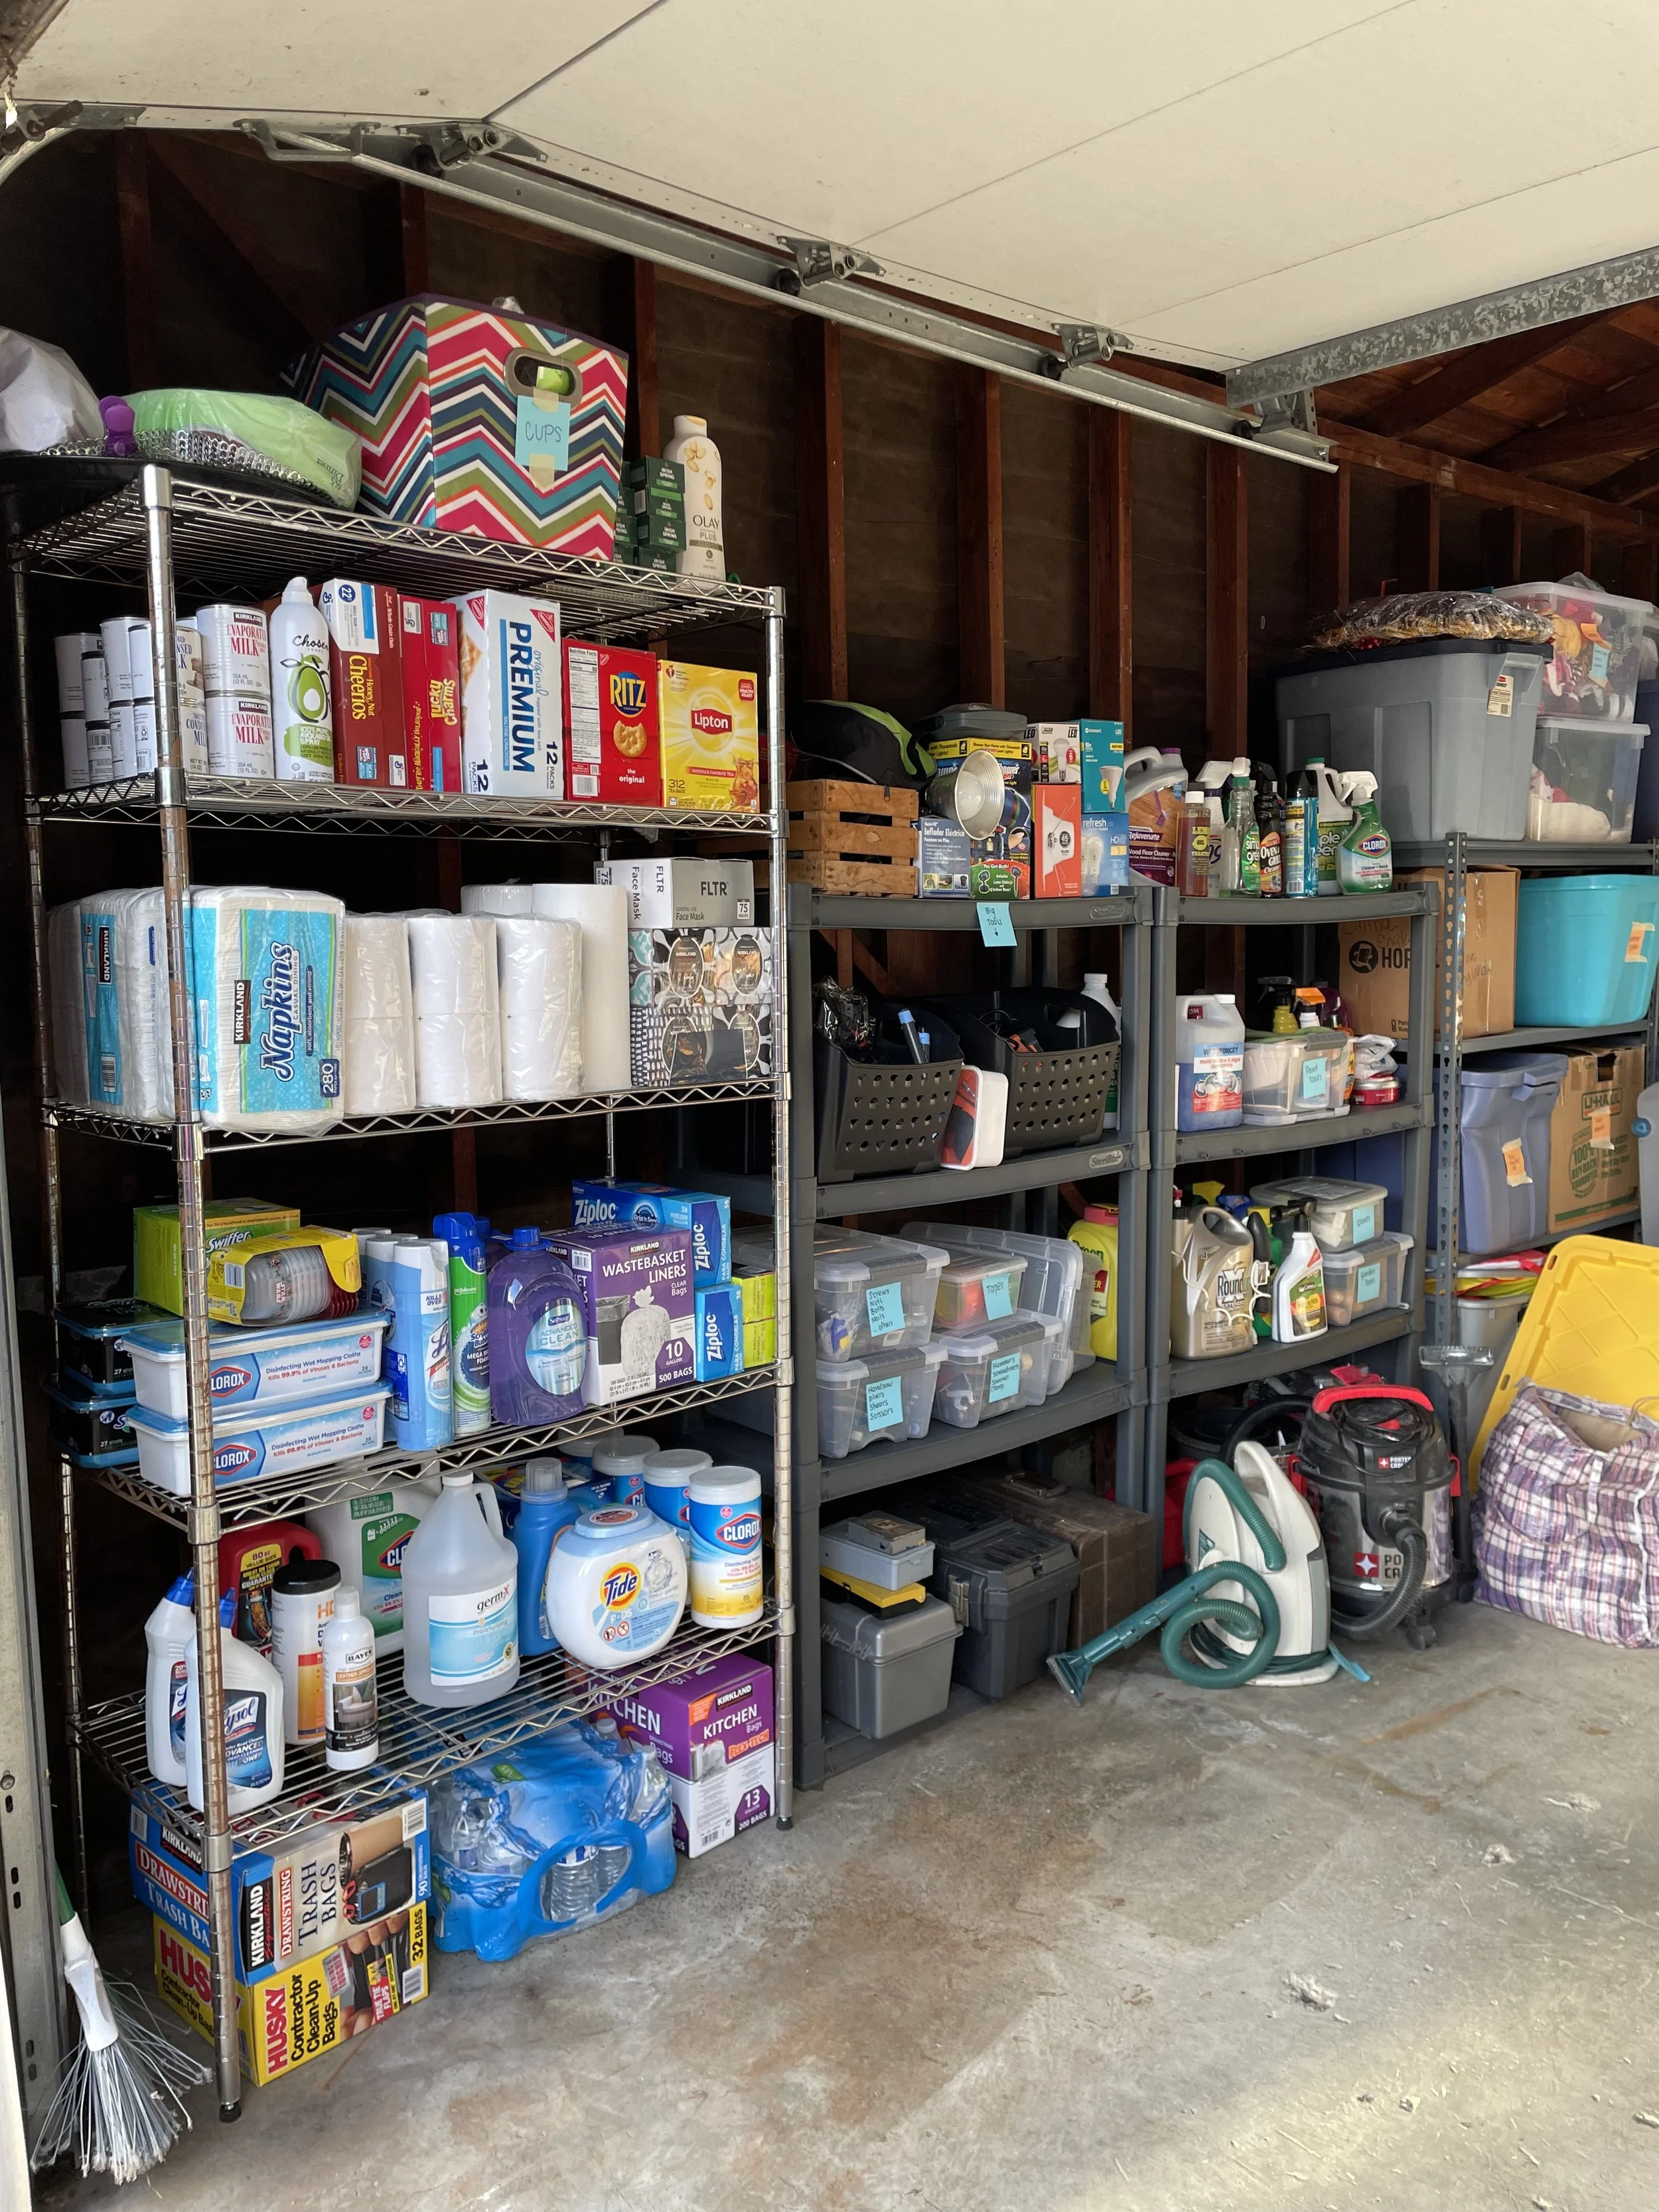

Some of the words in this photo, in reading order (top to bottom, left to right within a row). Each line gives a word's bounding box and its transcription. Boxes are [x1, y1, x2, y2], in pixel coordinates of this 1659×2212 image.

[525, 421, 562, 443] CUPS
[693, 514, 720, 530] OLAY
[235, 612, 263, 623] KIRKLAND
[232, 636, 259, 657] MILK
[533, 650, 549, 697] original
[349, 654, 367, 720] Cheerios
[509, 621, 535, 773] PREMIUM
[610, 674, 646, 708] RITZ
[240, 701, 268, 711] KIRKLAND
[694, 713, 729, 729] Lipton
[236, 726, 265, 745] MILK
[1024, 728, 1036, 739] LED
[1068, 727, 1078, 738] LED
[546, 741, 558, 765] 12
[476, 759, 488, 792] 12
[618, 775, 645, 784] original
[668, 779, 685, 789] 312
[924, 828, 945, 836] Inflador
[945, 828, 966, 837] Eléctrico
[1083, 817, 1107, 828] refresh
[1129, 831, 1160, 842] Rejuvenate
[1362, 840, 1388, 851] CLOROX
[701, 881, 727, 896] FLTR
[633, 893, 642, 921] Mask
[676, 912, 689, 921] Face
[690, 912, 705, 921] Mask
[739, 903, 748, 913] 75
[235, 981, 245, 1042] KIRKLAND
[261, 941, 303, 1082] Napkins
[323, 1063, 334, 1094] 280
[1090, 1153, 1122, 1167] Sterilite
[575, 1199, 616, 1226] Ziploc
[724, 1199, 729, 1209] 38
[206, 1231, 250, 1254] Swiffer
[630, 1242, 660, 1254] KIRKLAND
[693, 1222, 711, 1271] Ziploc
[602, 1249, 686, 1278] WASTEBASKET
[648, 1264, 687, 1284] LINERS
[671, 1280, 687, 1289] CLEAR
[671, 1286, 687, 1297] Bags
[736, 1290, 741, 1300] 38
[869, 1289, 890, 1300] Screws
[986, 1281, 1004, 1295] Tapes
[871, 1313, 885, 1323] Nails
[540, 1323, 577, 1337] ADVANCED
[540, 1329, 579, 1346] CLEAN
[707, 1313, 723, 1363] Ziploc
[666, 1341, 683, 1359] 10
[266, 1363, 301, 1374] Disinfecting
[317, 1355, 342, 1366] Mopping
[343, 1351, 361, 1361] Cloths
[281, 1370, 301, 1378] 99.9%
[337, 1359, 359, 1368] Bacteria
[659, 1372, 672, 1383] 500
[673, 1366, 693, 1378] BAGS
[271, 1439, 307, 1451] Disinfecting
[321, 1429, 346, 1439] Mopping
[347, 1423, 364, 1432] Cloths
[287, 1445, 307, 1454] 99.9%
[315, 1439, 334, 1448] Viruses
[341, 1431, 363, 1441] Bacteria
[723, 1522, 760, 1542] CLOROX
[604, 1572, 638, 1607] Tide
[717, 1685, 752, 1706] KIRKLAND
[703, 1704, 758, 1739] KITCHEN
[746, 1721, 762, 1733] Bags
[728, 1729, 770, 1760] FLEX-TECH
[744, 1789, 760, 1806] 13
[750, 1810, 767, 1826] BAGS
[321, 1862, 336, 1925] BAGS
[418, 1882, 428, 1896] 90
[144, 1879, 187, 1926] TRASH
[279, 1870, 293, 1955] DRAWSTRING
[299, 1860, 319, 1947] TRASH
[251, 1885, 263, 1967] KIRKLAND
[414, 1907, 423, 1938] BAGS
[412, 1938, 424, 1962] 32
[161, 1969, 200, 2009] Contractor
[381, 1985, 392, 2010] FLAPS
[291, 1974, 304, 2062] Contractor
[306, 1980, 321, 2053] Clean-Up
[322, 2001, 340, 2046] Bags
[265, 1988, 288, 2074] HUSKY
